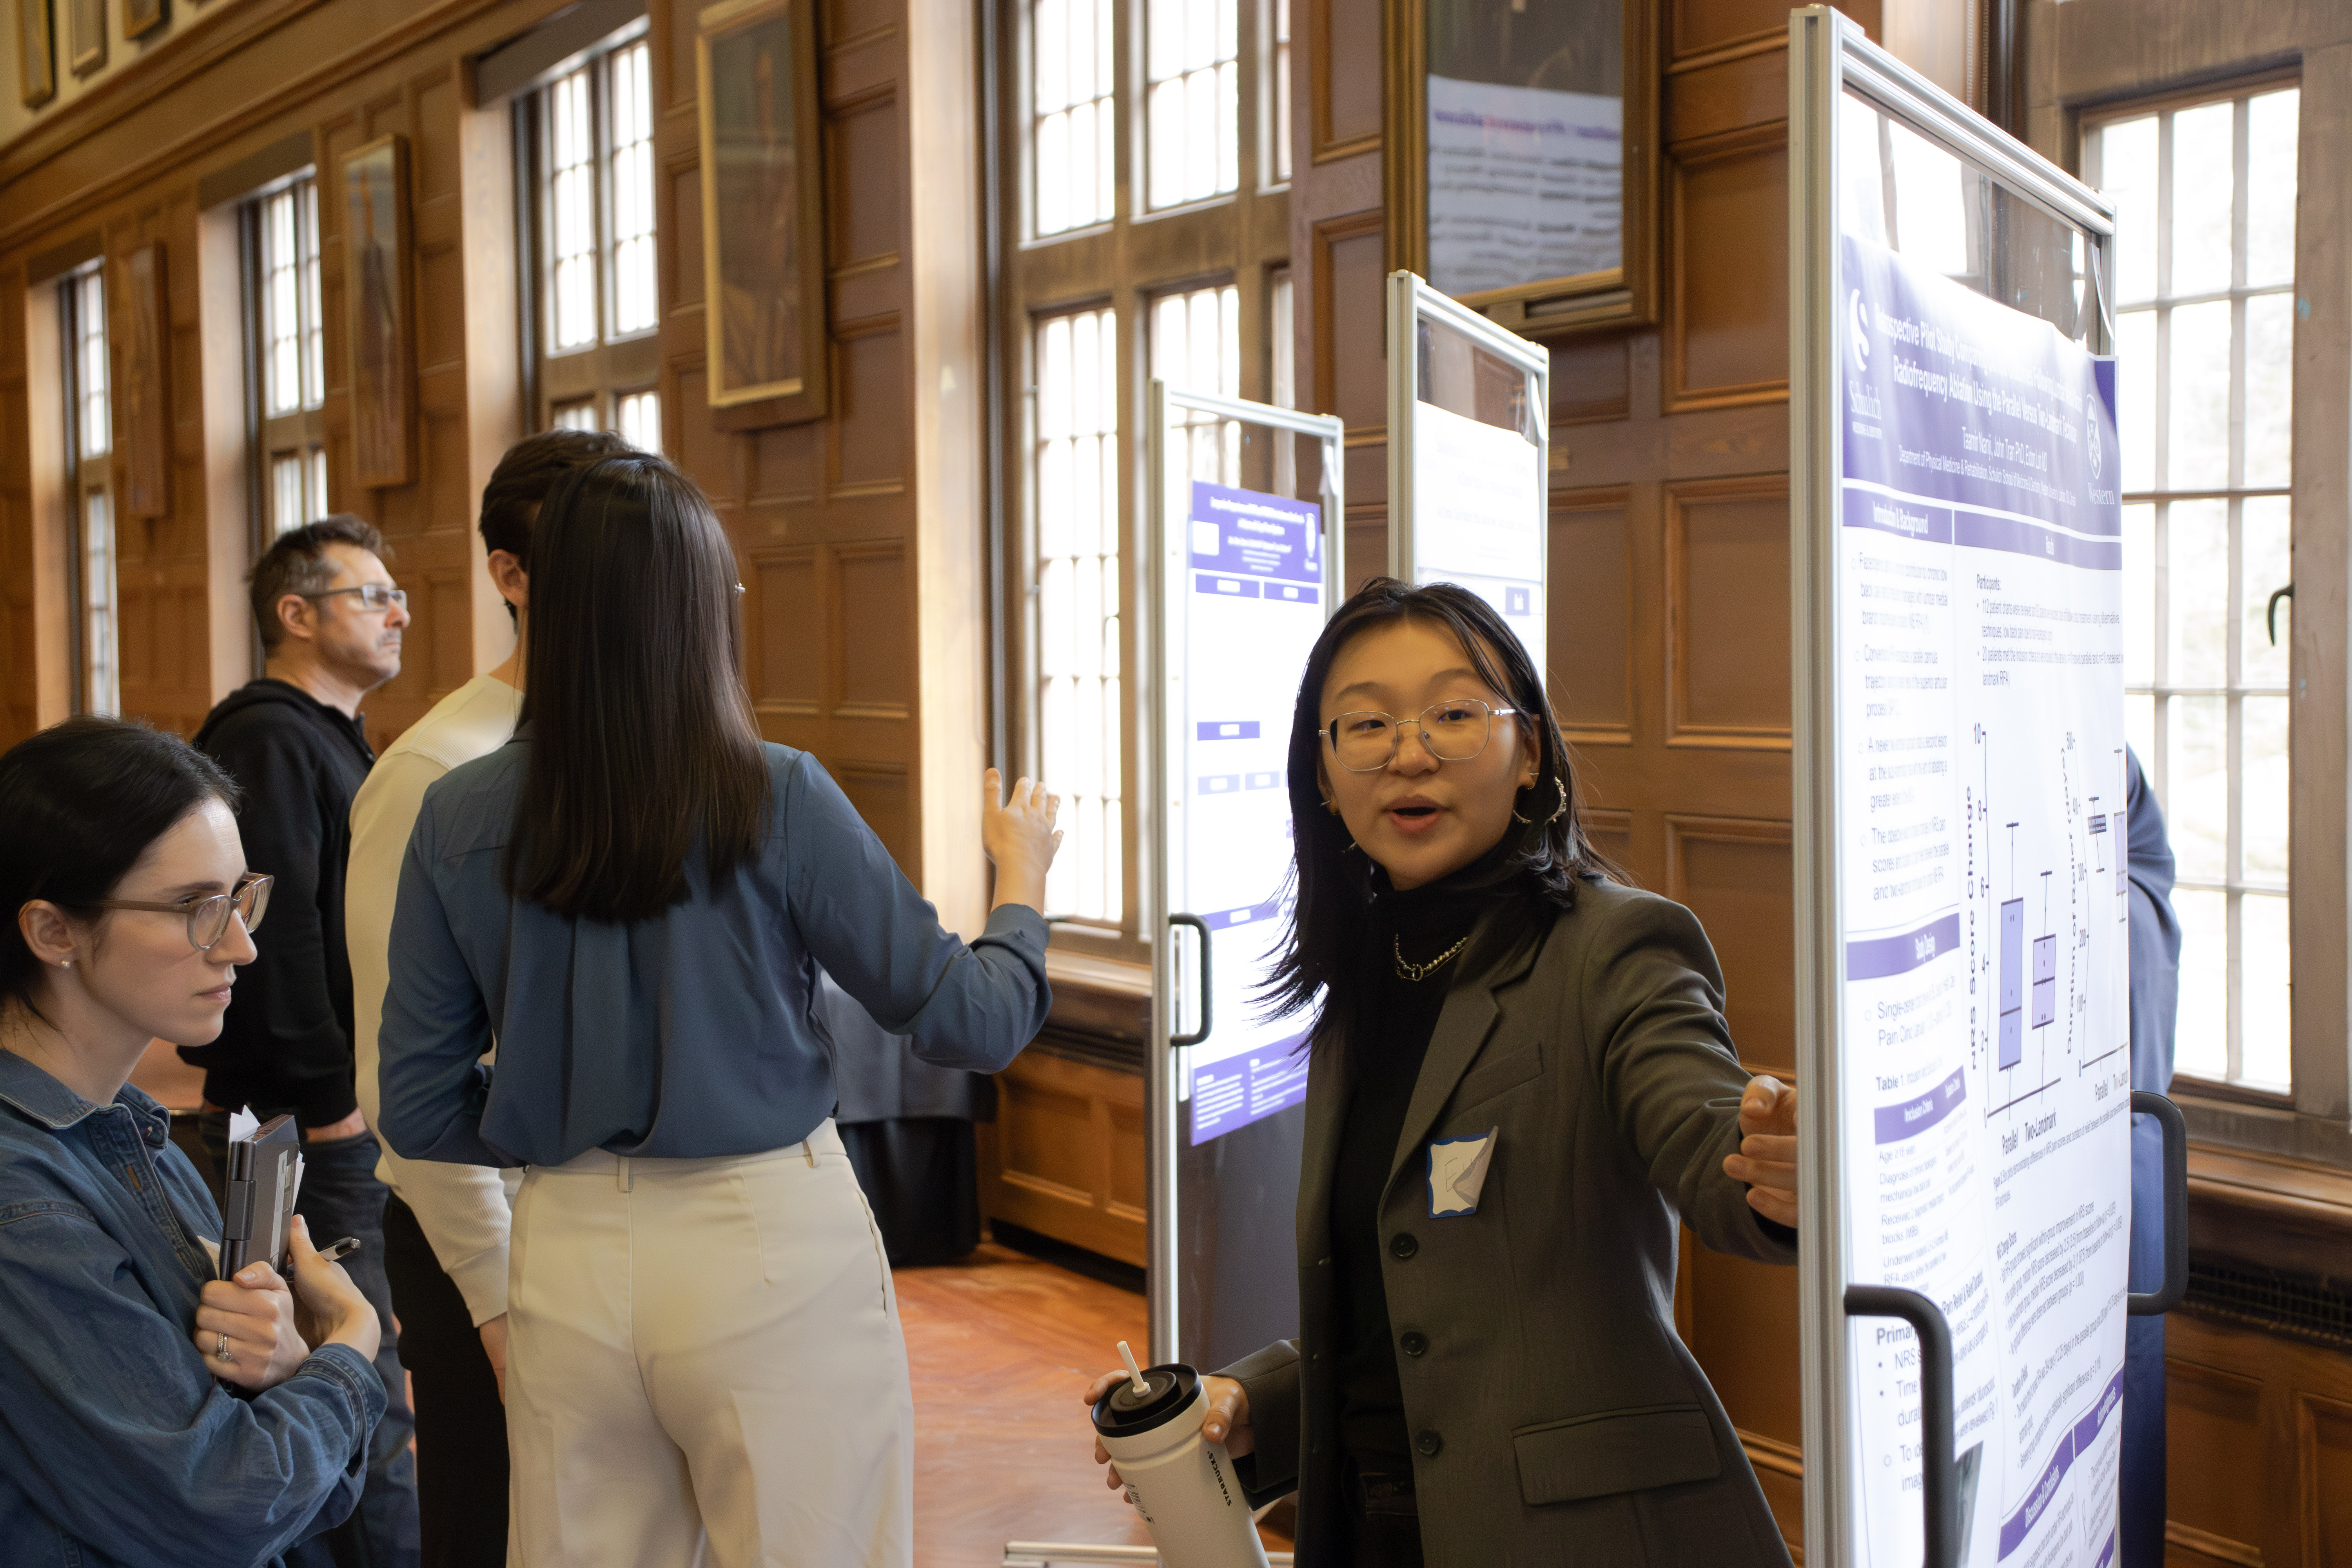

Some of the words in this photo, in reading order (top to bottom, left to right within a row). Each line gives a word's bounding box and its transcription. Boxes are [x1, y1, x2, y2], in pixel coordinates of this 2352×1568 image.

[1921, 320, 1936, 352] Pilot
[1936, 327, 1954, 364] Study
[1849, 380, 1882, 419] Schulich
[1893, 355, 1947, 402] Radiofrequency
[1949, 372, 1973, 403] Ablation
[1973, 381, 1992, 416] Using
[1992, 387, 2001, 407] the
[2001, 390, 2021, 422] Parallel
[2021, 395, 2037, 425] Versus
[1926, 450, 1942, 473] Physical
[1942, 454, 1960, 474] Medicine
[1994, 436, 2004, 458] John
[2005, 438, 2014, 461] Tran
[2015, 443, 2025, 467] PhD,
[2088, 482, 2114, 505] Western
[1899, 508, 1928, 537] Background
[1990, 599, 2002, 618] patient
[1982, 646, 1987, 662] 20
[1988, 646, 2002, 664] patients
[1982, 670, 1999, 686] landmark
[1974, 722, 1981, 745] 10
[1869, 736, 1874, 753] A
[1869, 764, 1877, 781] at
[1978, 799, 1982, 821] 8
[1872, 827, 1886, 844] The
[1873, 857, 1894, 873] scores
[1873, 883, 1889, 900] and
[1981, 876, 1985, 898] 6
[1982, 953, 1985, 975] 4
[2067, 945, 2076, 1054] Duration
[2072, 911, 2076, 937] of
[1878, 1028, 1898, 1046] Pain
[1981, 1030, 1984, 1053] 2
[2079, 1058, 2082, 1078] 0
[1876, 1074, 1899, 1091] Table
[2095, 1077, 2108, 1103] Parallel
[1903, 1102, 1922, 1123] Inclusion
[1984, 1107, 1987, 1129] 0
[2002, 1127, 2018, 1157] Parallel
[2025, 1107, 2056, 1142] Two-Landmark
[1878, 1149, 1893, 1164] Age
[1880, 1184, 1913, 1204] mechanical
[1881, 1209, 1910, 1227] Received
[1882, 1229, 1904, 1246] blocks
[1882, 1250, 1915, 1268] Underwent
[1884, 1270, 1900, 1287] RFA
[1902, 1270, 1915, 1285] using
[1953, 1288, 1963, 1315] Relief
[1894, 1347, 1916, 1370] NRS
[1895, 1378, 1918, 1399] Time
[1898, 1406, 1921, 1428] durat
[1899, 1443, 1912, 1463] To
[1209, 1452, 1232, 1506] STARBUCKS
